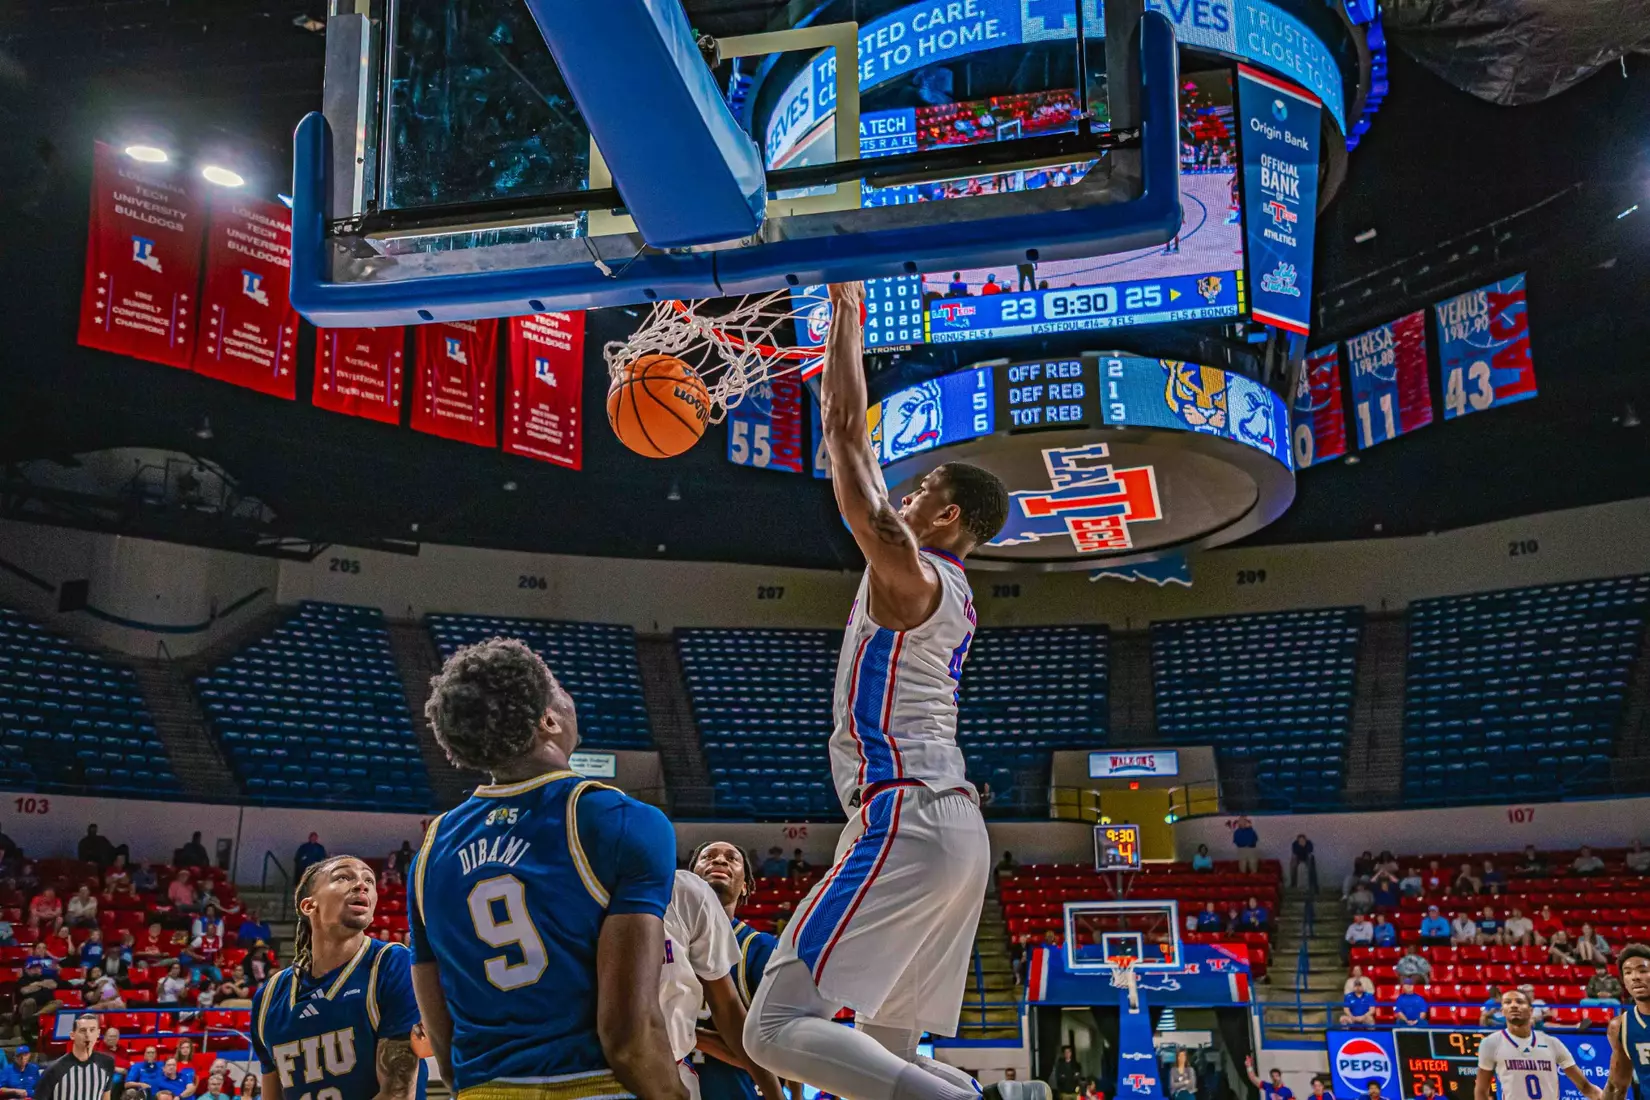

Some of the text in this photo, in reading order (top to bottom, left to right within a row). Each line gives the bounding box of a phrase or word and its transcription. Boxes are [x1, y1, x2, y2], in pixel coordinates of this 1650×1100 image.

[912, 0, 985, 33] CARE,
[880, 44, 911, 71] TO
[918, 19, 1006, 58] HOME.
[1246, 6, 1319, 62] TRUSTED
[1249, 32, 1303, 74] CLOSE
[1306, 66, 1323, 89] TO
[870, 116, 906, 134] TECH
[1250, 117, 1309, 151] Origin Bank
[891, 138, 898, 147] A
[902, 136, 915, 145] FL
[1260, 153, 1299, 179] OFFICIAL
[1261, 167, 1300, 199] BANK
[113, 191, 187, 220] UNIVERSITY
[114, 204, 184, 232] BULLDOGS
[232, 205, 292, 233] LOUISIANA
[226, 228, 291, 256] UNIVERSITY
[247, 222, 277, 240] TECH
[1263, 228, 1297, 247] ATHLETICS
[227, 240, 290, 268] BULLDOGS
[869, 284, 918, 299] 1 1 0 1
[1001, 284, 1162, 321] 23 9:30 25
[868, 299, 920, 313] 3 0 1 0
[1171, 310, 1188, 320] FLS
[1200, 306, 1236, 317] BONUS
[1438, 291, 1488, 327] VENUS
[520, 319, 573, 341] UNIVERSITY
[534, 314, 559, 328] TECH
[868, 313, 920, 328] 4 0 2 0
[1116, 316, 1135, 325] FLS
[522, 330, 571, 351] BULLDOGS
[869, 328, 921, 343] 0 0 0 2
[933, 330, 966, 342] BONUS
[969, 329, 986, 340] FLS
[1346, 327, 1394, 361] TERESA
[976, 359, 1124, 389] 1 OFF REB 2
[973, 381, 1118, 410] 5 DEF REB 1
[1445, 361, 1494, 416] 43
[973, 402, 1126, 432] 6 TOT REB 3
[1357, 393, 1396, 448] 11
[731, 420, 771, 468] 55
[1508, 539, 1539, 557] 210
[329, 558, 361, 574] 205
[1236, 569, 1266, 584] 209
[518, 575, 548, 590] 206
[757, 585, 784, 600] 207
[14, 797, 50, 815] 103
[1507, 808, 1535, 824] 107
[1106, 829, 1135, 843] 9:30
[1118, 843, 1132, 864] 4
[466, 873, 549, 992] 9
[272, 1026, 357, 1089] FIU
[1340, 1059, 1389, 1072] PEPSI
[1504, 1059, 1552, 1072] LOUISIANA TECH
[1525, 1074, 1542, 1100] 0
